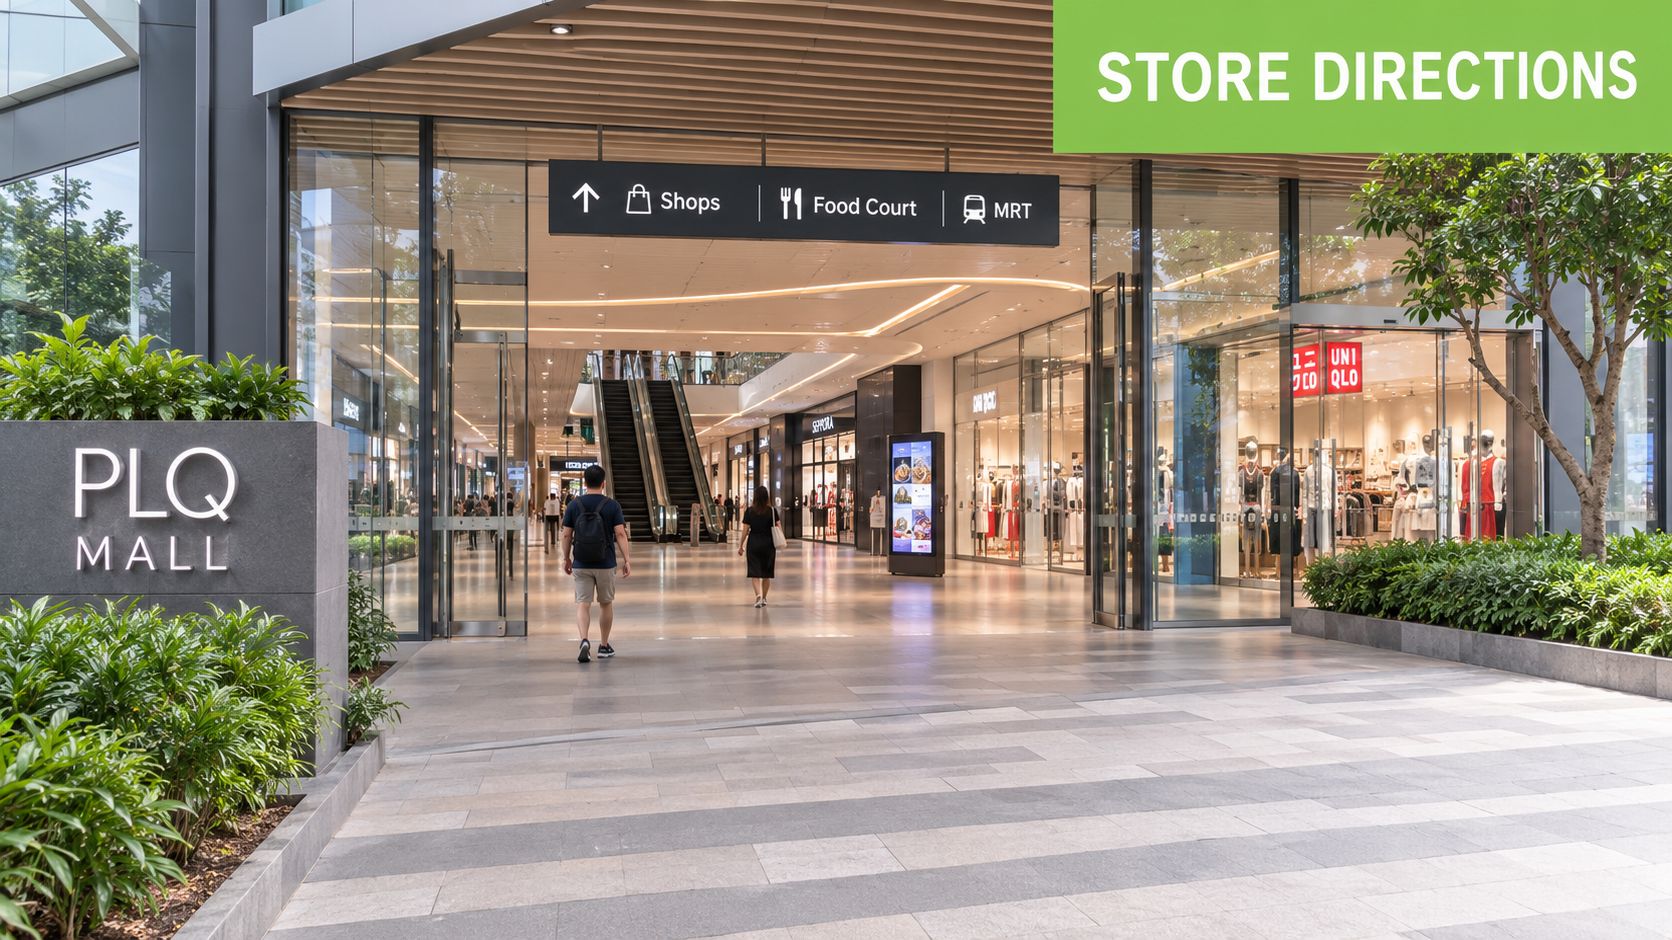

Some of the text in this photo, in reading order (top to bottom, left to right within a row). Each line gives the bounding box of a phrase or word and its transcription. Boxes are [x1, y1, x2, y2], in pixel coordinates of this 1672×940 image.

[660, 190, 1033, 220] Shops Food Court MRT
[1331, 347, 1357, 366] UNI
[1331, 368, 1359, 389] QLO
[74, 446, 238, 522] PLQ
[76, 535, 230, 572] MALL
